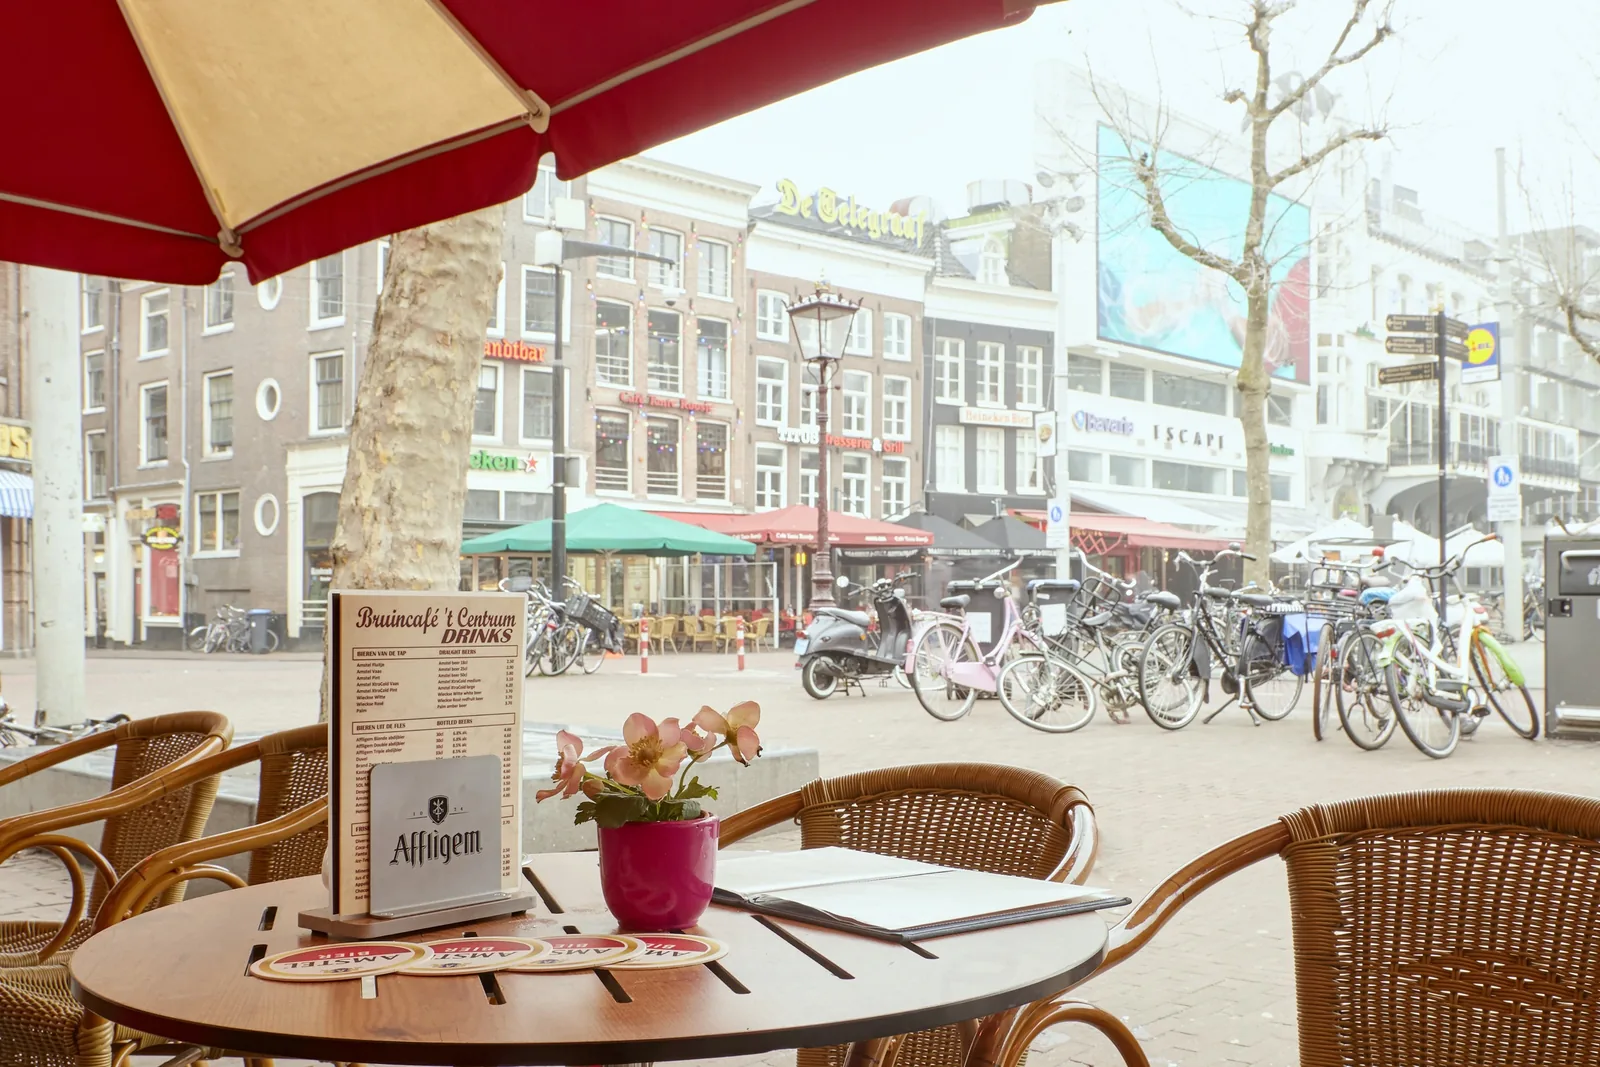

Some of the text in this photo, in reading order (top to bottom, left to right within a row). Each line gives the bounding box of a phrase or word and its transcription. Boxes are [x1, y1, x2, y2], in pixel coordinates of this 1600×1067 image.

[776, 178, 927, 249] De Telegraaf
[966, 410, 1030, 425] Heineken Bier
[1085, 412, 1134, 436] Bavaria
[1154, 424, 1224, 450] ESCAPE
[872, 437, 882, 452] &
[883, 441, 905, 454] Grill
[356, 606, 516, 634] Bruincafé 't Centrum
[441, 628, 513, 644] DRINKS
[389, 829, 481, 868] Affligem
[318, 950, 370, 960] BIER
[432, 951, 517, 961] AMST
[444, 945, 495, 953] BIER
[644, 950, 690, 958] AM
[285, 954, 399, 970] AMSTEL
